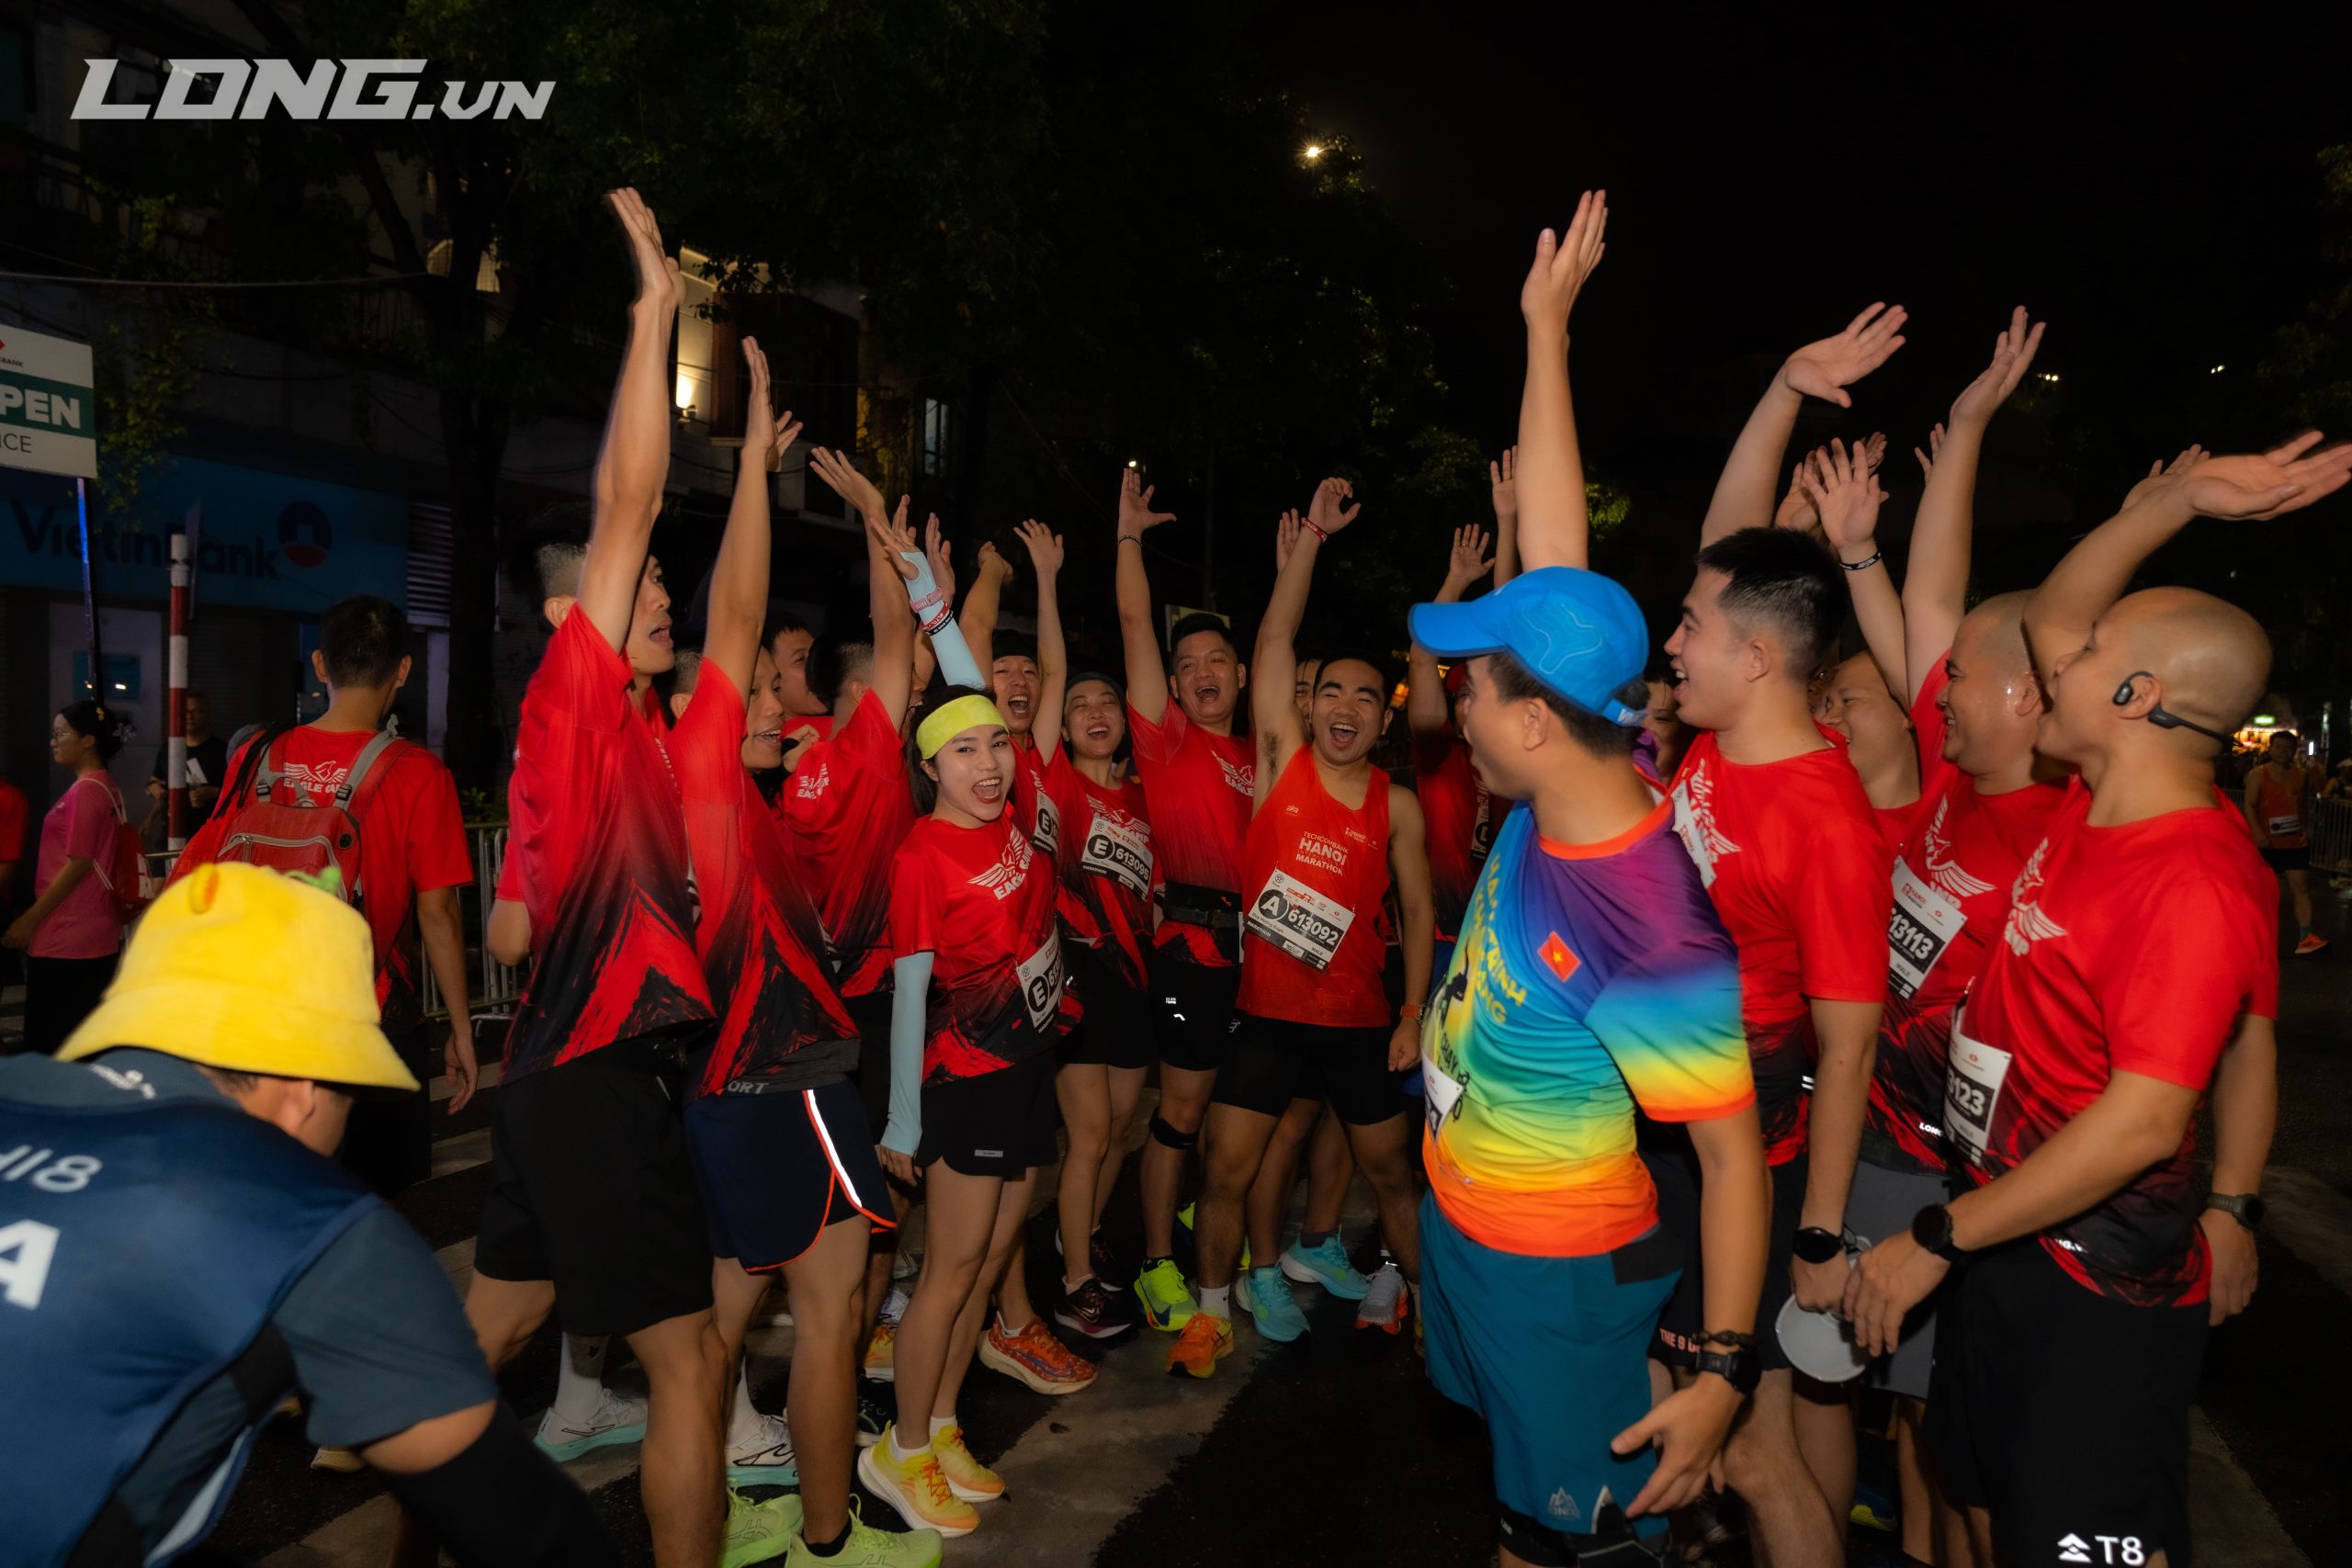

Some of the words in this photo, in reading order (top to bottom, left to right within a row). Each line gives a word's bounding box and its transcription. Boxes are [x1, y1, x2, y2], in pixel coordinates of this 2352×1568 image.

[1298, 837, 1347, 866] HANOI
[1304, 831, 1349, 855] TECHCOMBANK
[1093, 838, 1108, 855] E
[1115, 849, 1149, 881] 613095
[1295, 853, 1344, 875] MARATHON
[1247, 920, 1272, 938] MARATHON
[1261, 895, 1280, 917] A
[1287, 908, 1339, 945] 613092
[1032, 980, 1046, 1008] E
[2095, 1535, 2145, 1566] T8
